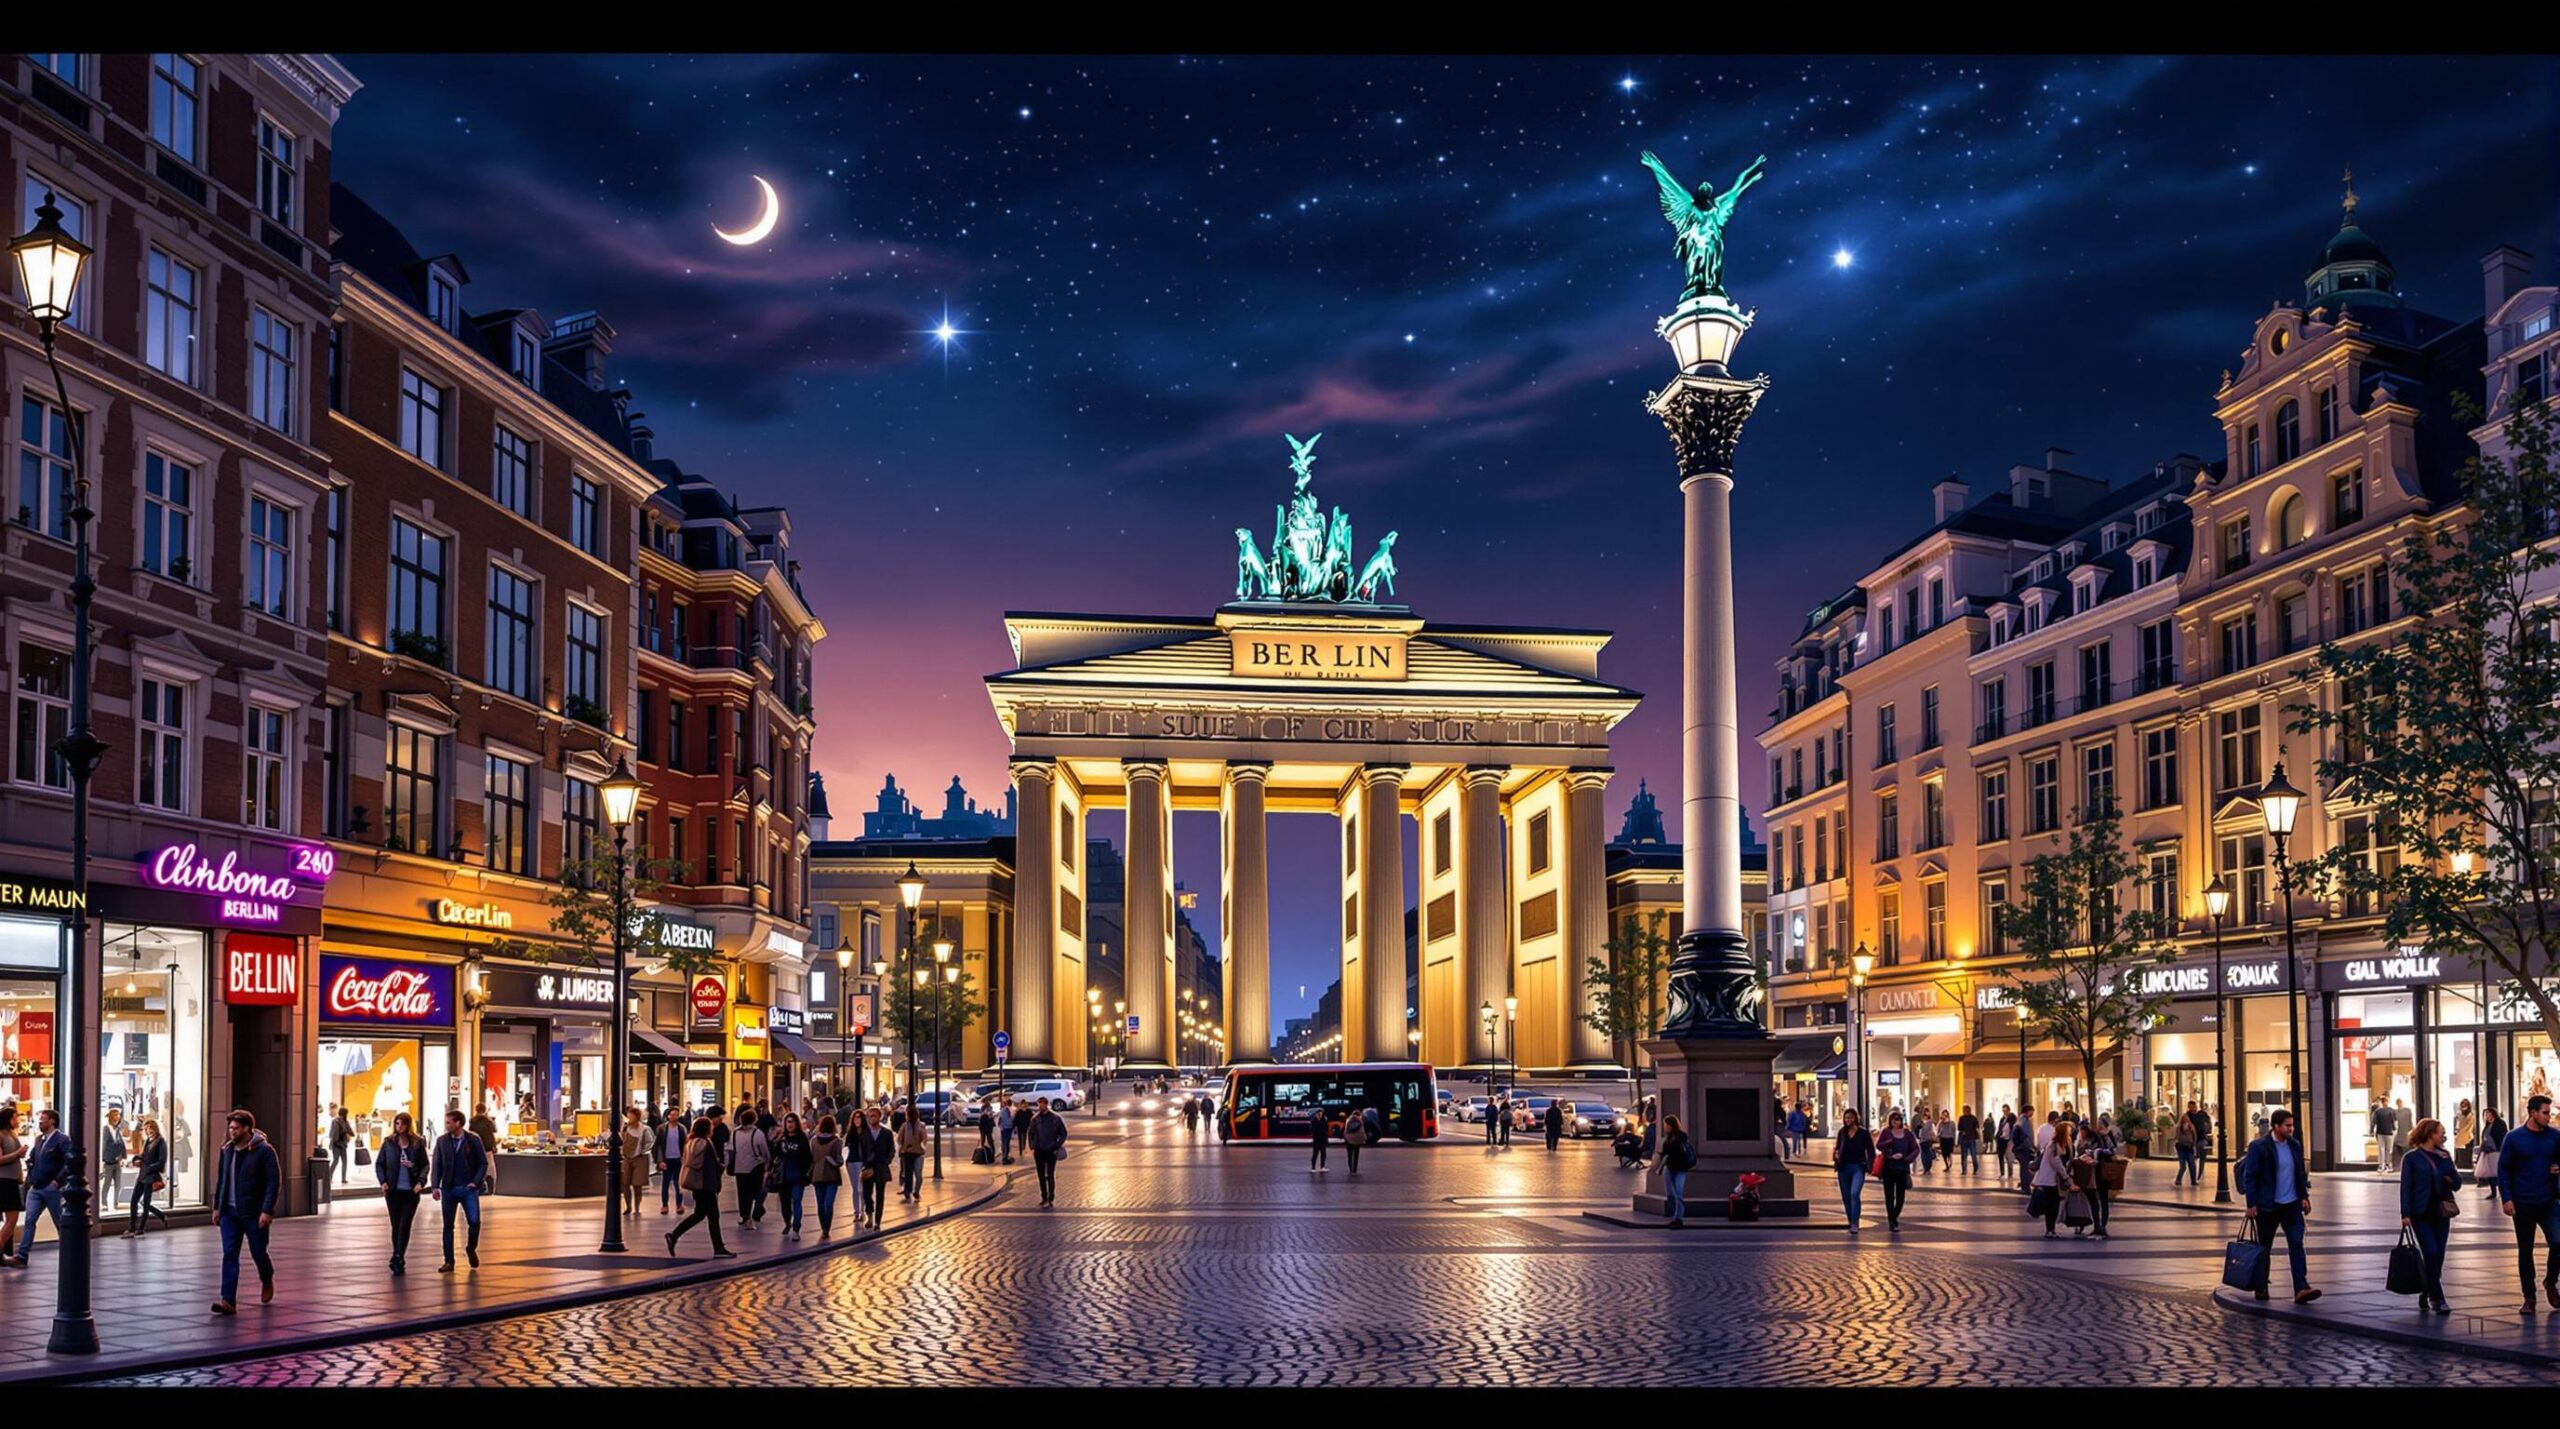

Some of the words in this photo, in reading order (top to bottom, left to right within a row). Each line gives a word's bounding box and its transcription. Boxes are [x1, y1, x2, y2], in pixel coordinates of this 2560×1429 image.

[0, 884, 24, 904] ER
[29, 887, 87, 909] MAUN
[230, 950, 296, 994] BELLIN
